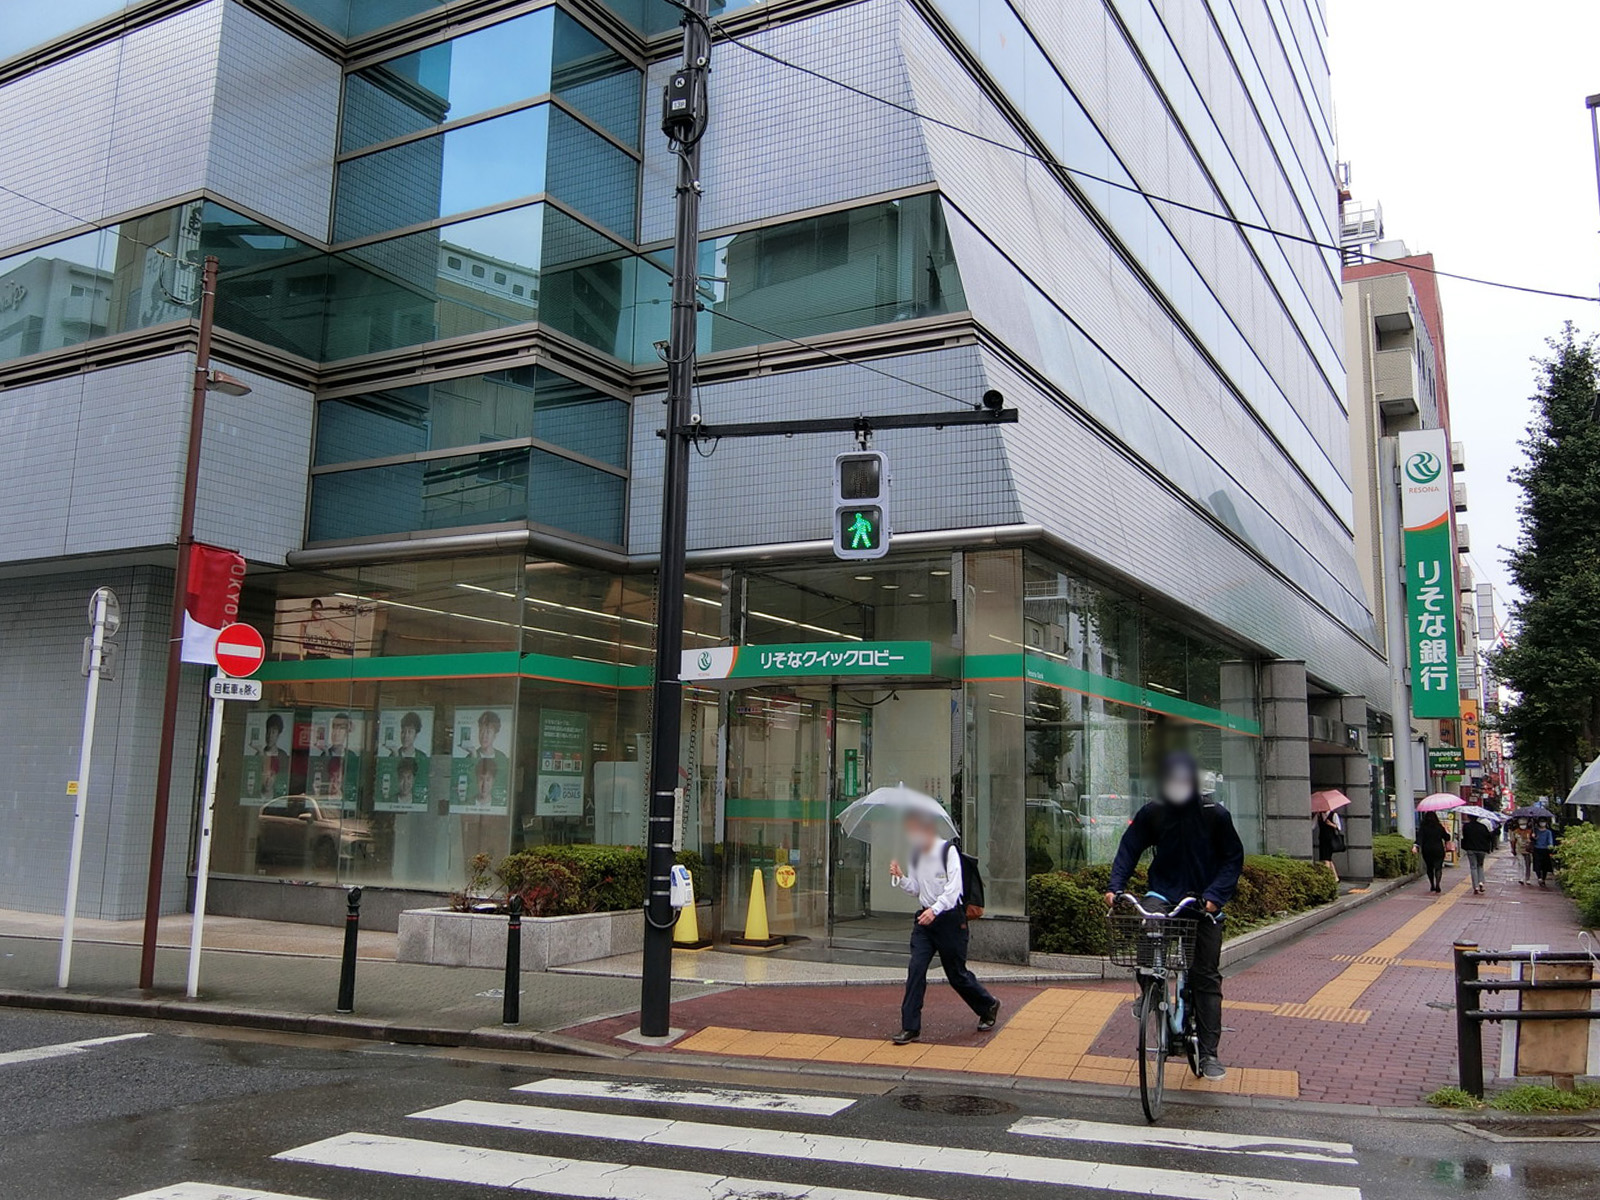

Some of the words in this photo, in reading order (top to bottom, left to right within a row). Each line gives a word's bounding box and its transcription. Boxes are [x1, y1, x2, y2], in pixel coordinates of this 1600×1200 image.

[1408, 486, 1440, 494] RESONA
[224, 564, 246, 615] OKYO
[1416, 560, 1448, 691] りそな銀行
[760, 649, 904, 670] りそなクイックロビー
[214, 682, 257, 696] 自転車を除く
[1465, 728, 1476, 748] 松屋
